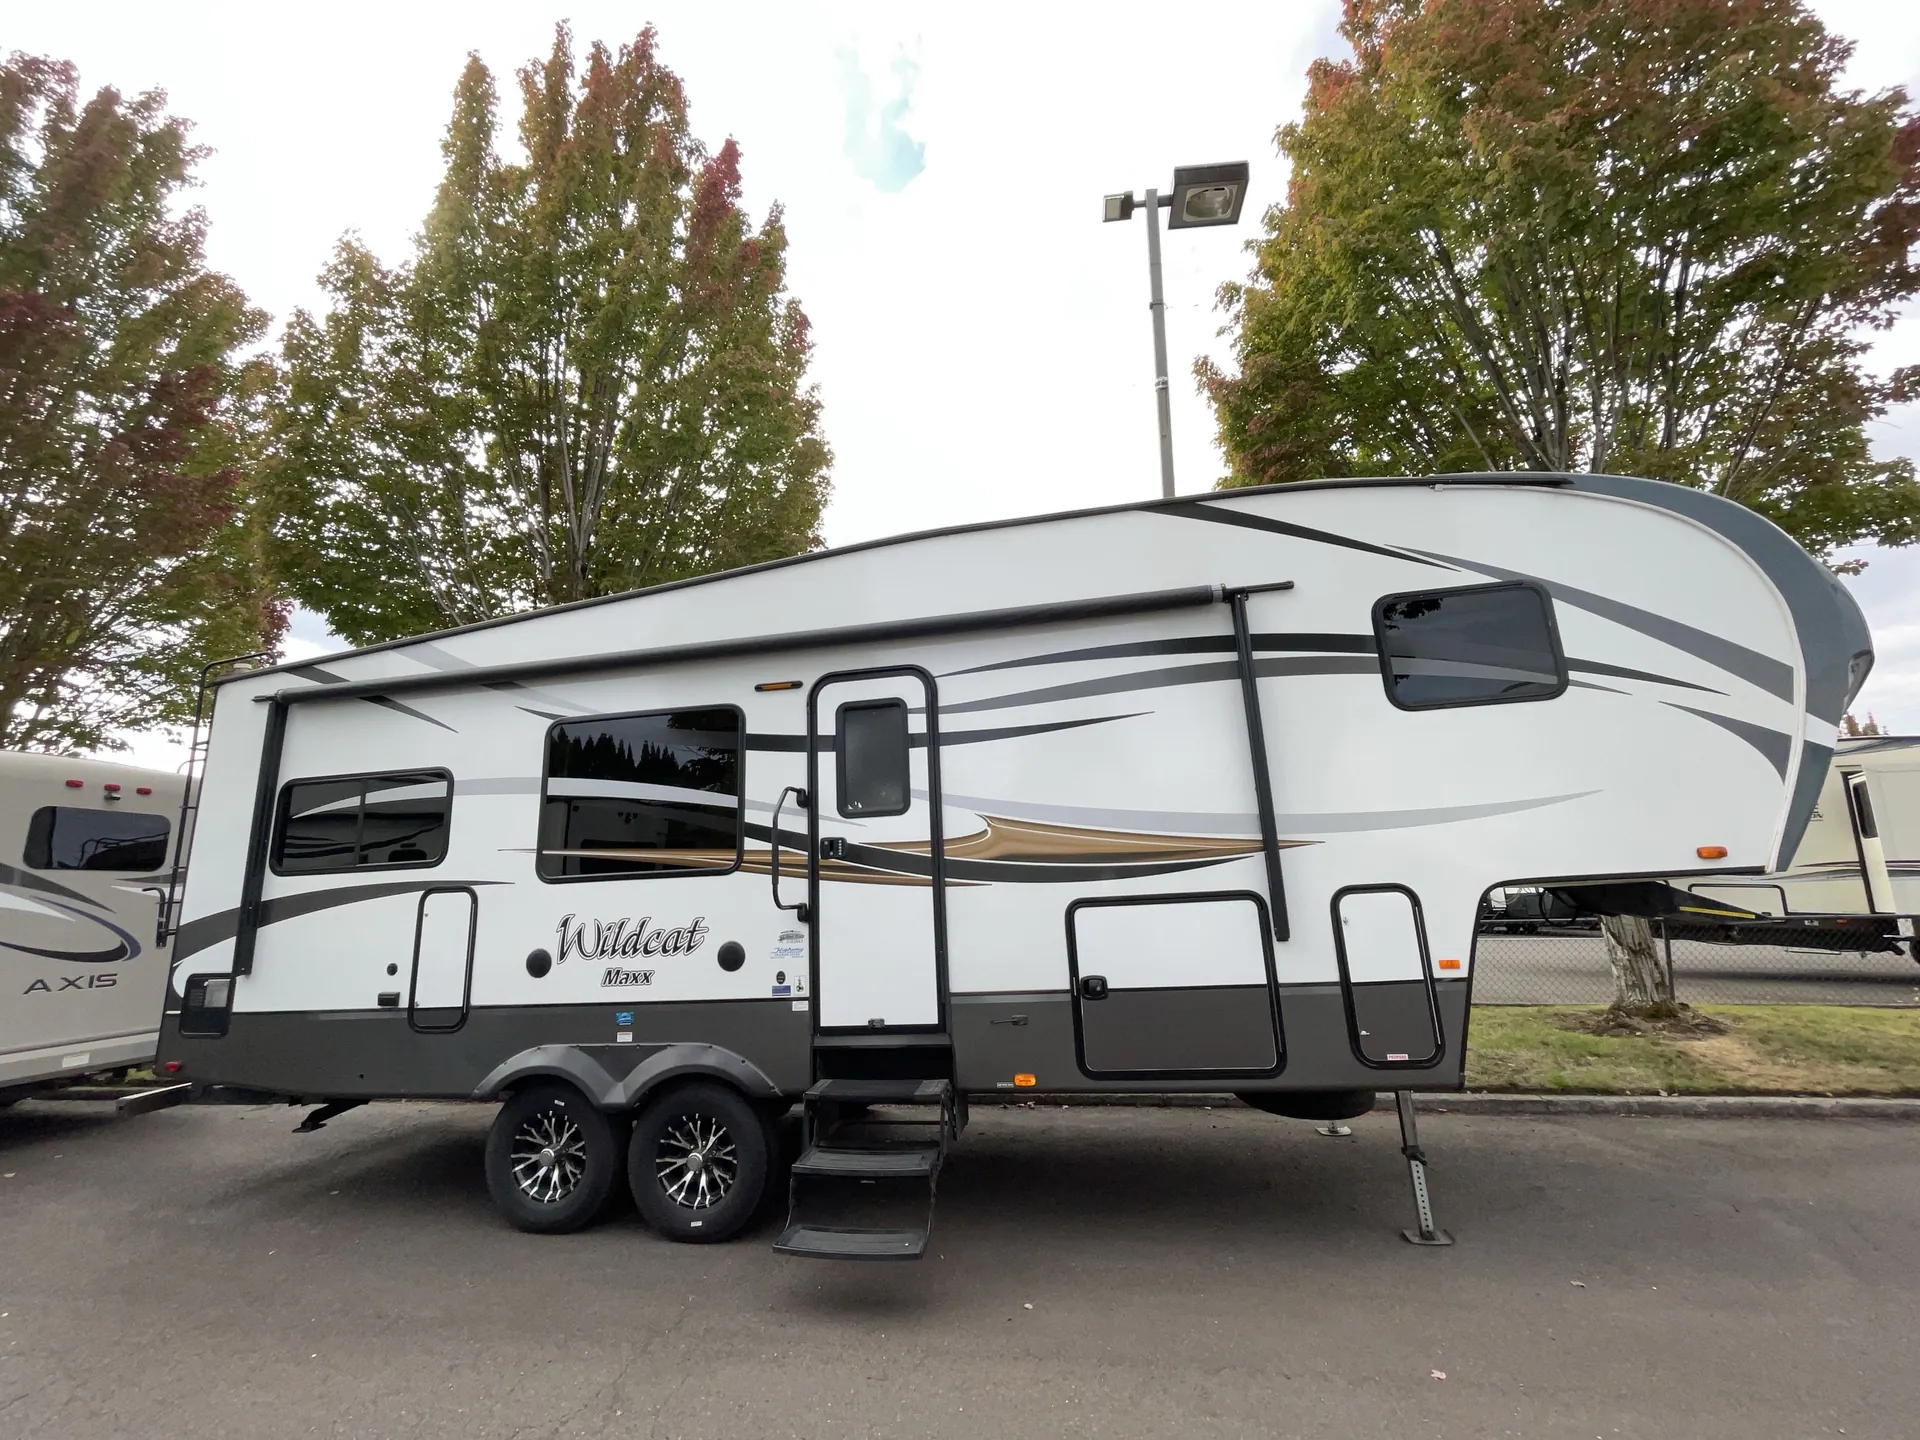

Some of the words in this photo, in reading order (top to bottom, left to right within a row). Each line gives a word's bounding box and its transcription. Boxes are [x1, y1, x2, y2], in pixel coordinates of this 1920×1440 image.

[556, 914, 709, 965] Wildcat
[22, 973, 118, 995] AXIS
[601, 967, 655, 987] Maxx
